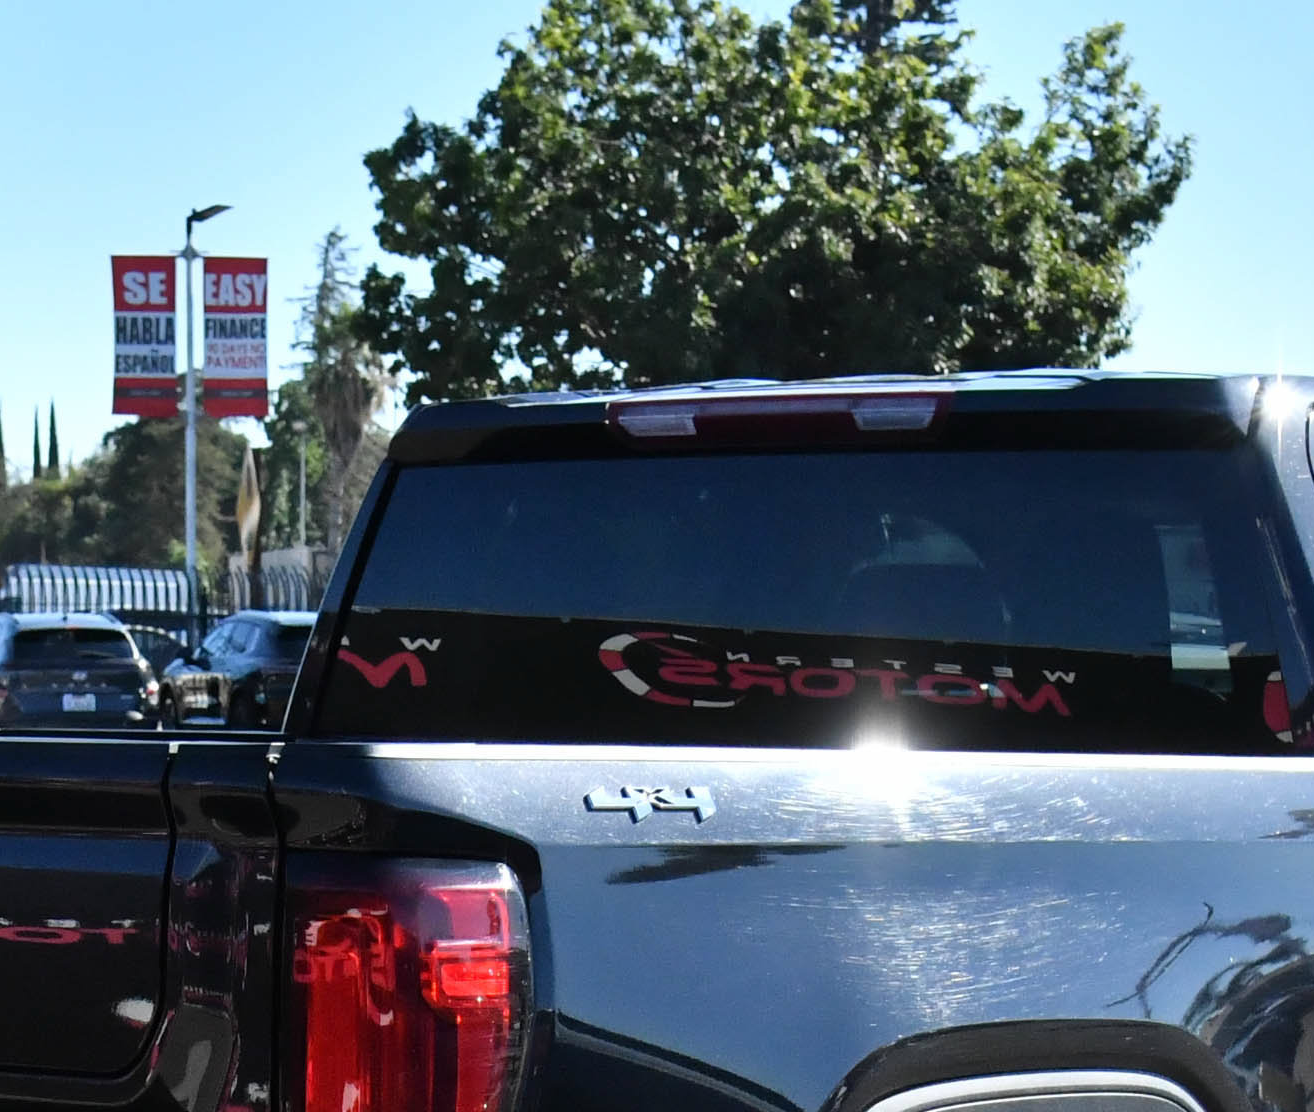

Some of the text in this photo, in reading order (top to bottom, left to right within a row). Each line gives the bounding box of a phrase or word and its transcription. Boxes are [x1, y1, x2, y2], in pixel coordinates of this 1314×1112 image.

[122, 271, 167, 304] SE
[205, 273, 266, 307] EASY
[115, 317, 175, 345] HABLA
[205, 318, 266, 339] FINANCE
[115, 348, 175, 374] ESPAÑOL
